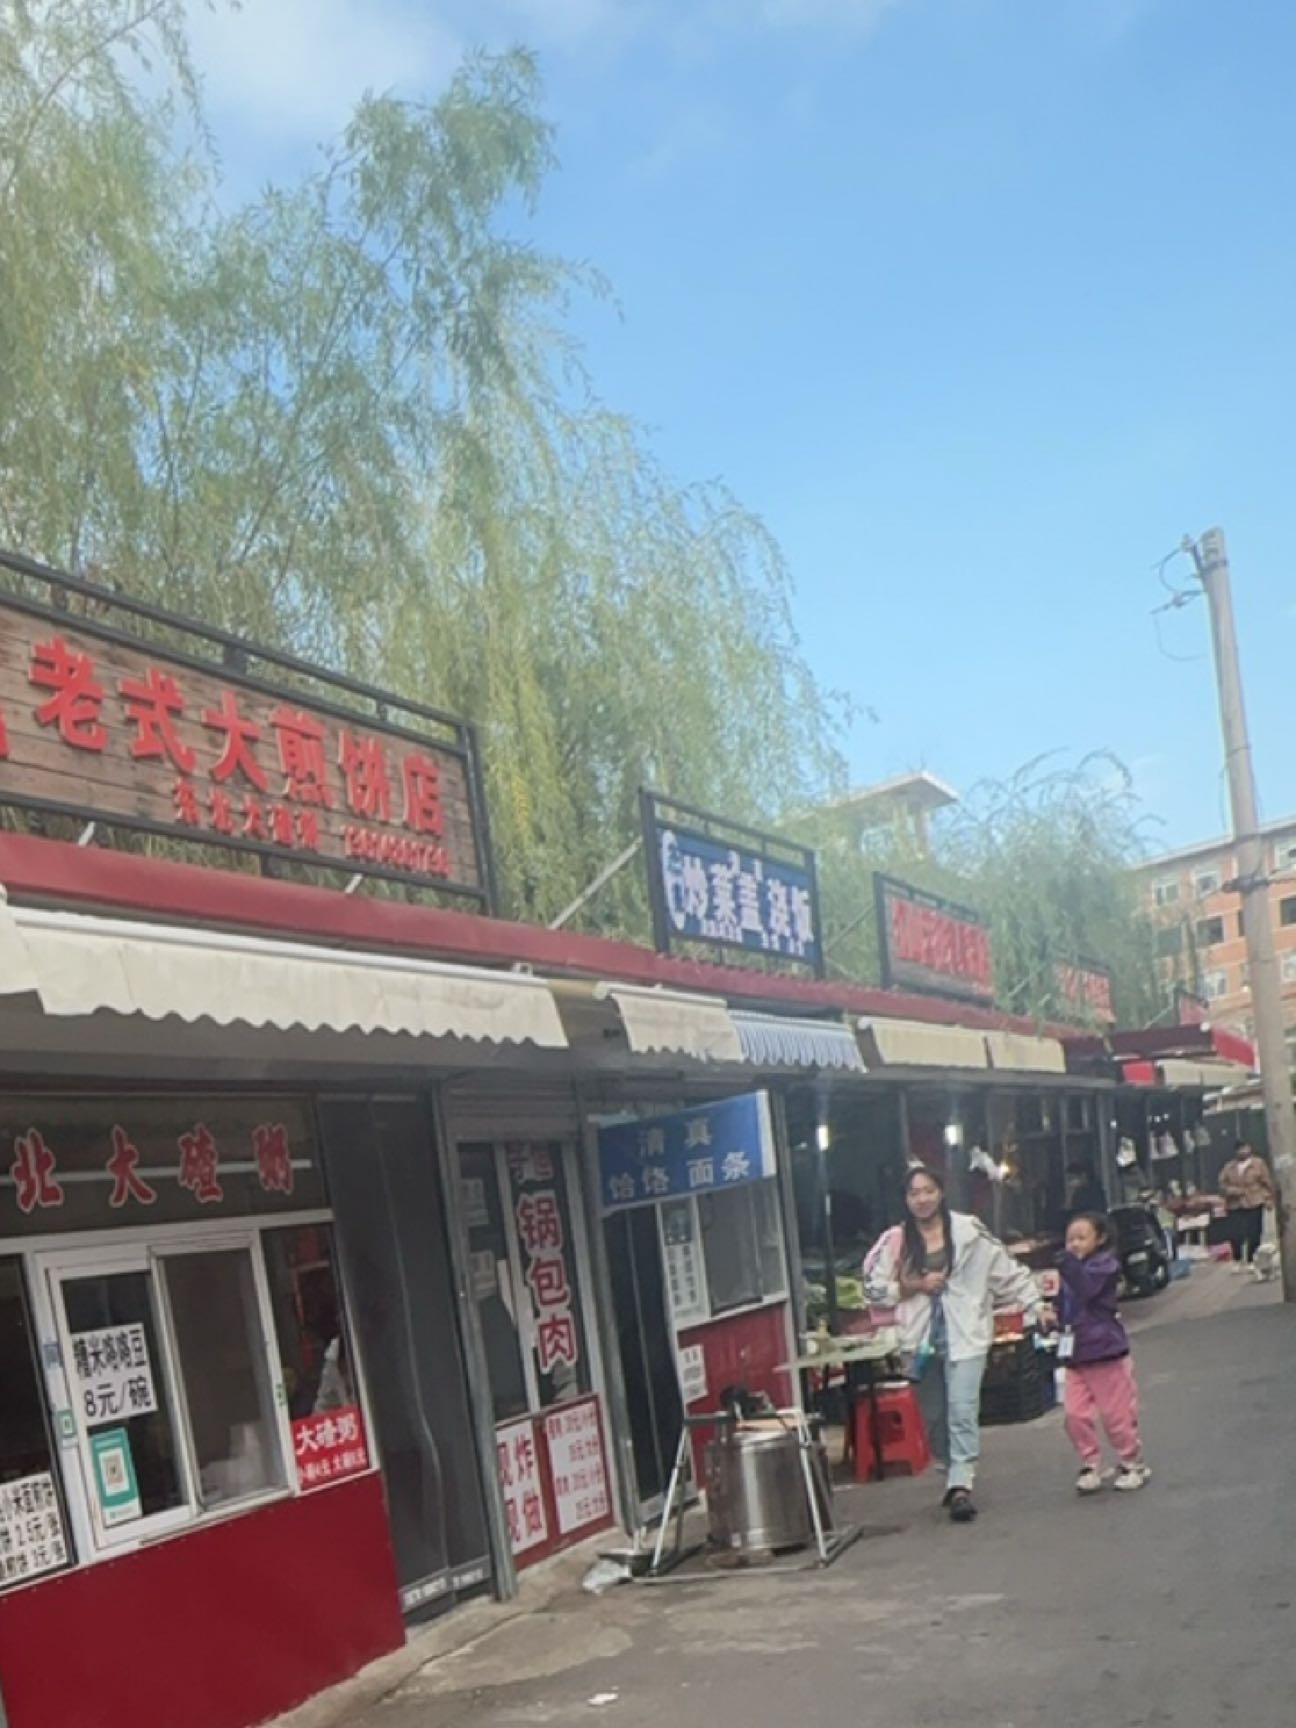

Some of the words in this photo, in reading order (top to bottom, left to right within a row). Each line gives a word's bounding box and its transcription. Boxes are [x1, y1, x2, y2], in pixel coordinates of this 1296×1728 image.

[29, 631, 446, 838] 老式大煎饼店
[518, 1191, 578, 1375] 锅包肉
